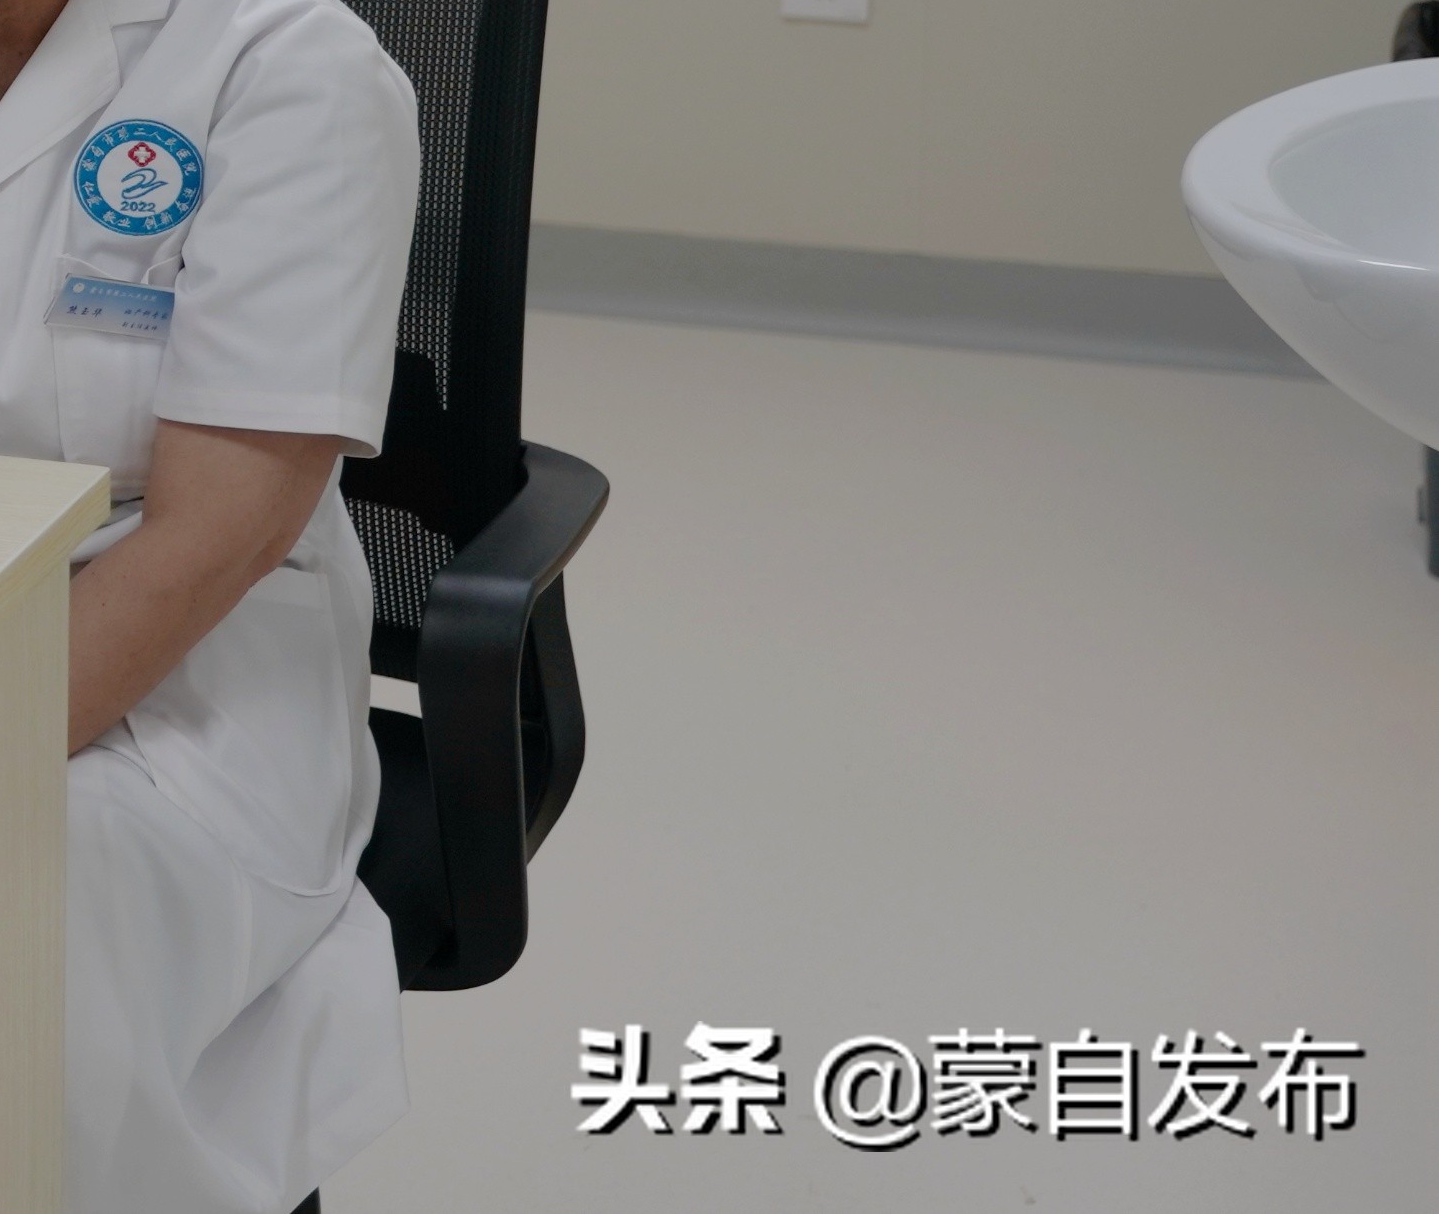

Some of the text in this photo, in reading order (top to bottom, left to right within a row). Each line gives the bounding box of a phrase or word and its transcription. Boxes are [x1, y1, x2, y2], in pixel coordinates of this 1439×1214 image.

[81, 126, 198, 176] 蒙自市第二人民医院
[120, 201, 157, 212] 2022
